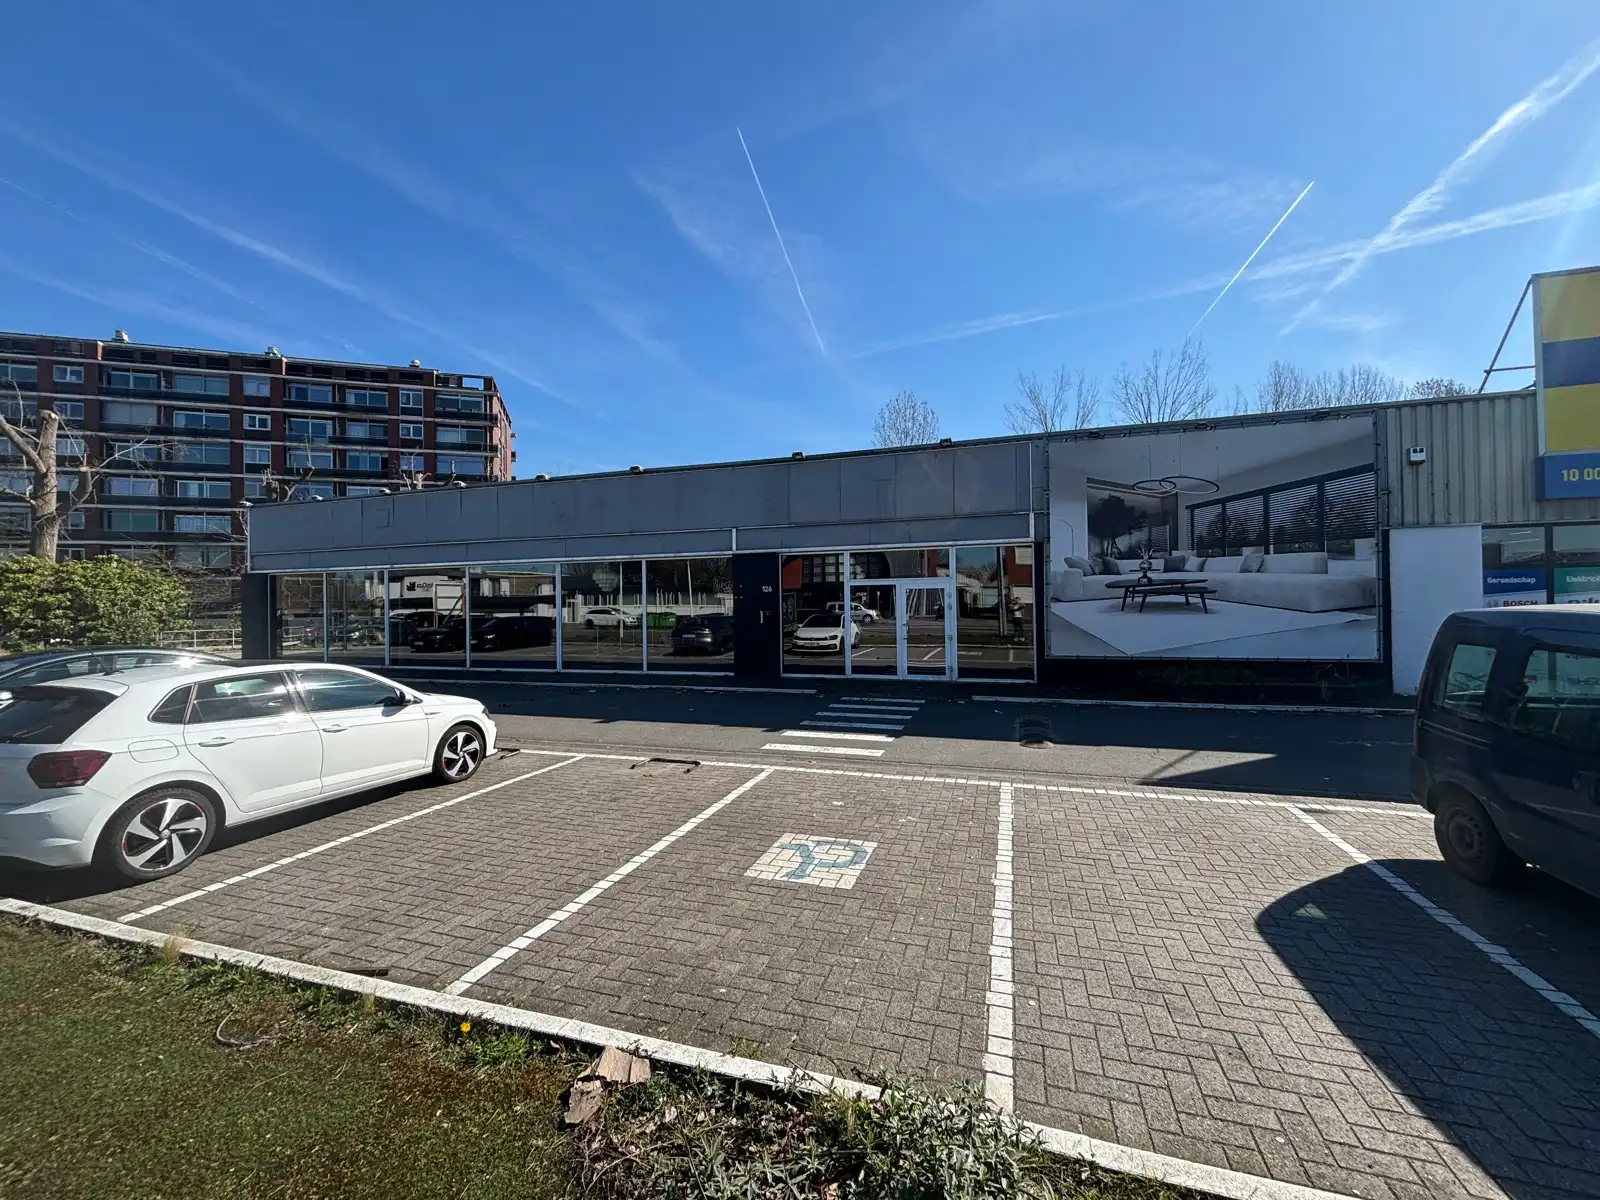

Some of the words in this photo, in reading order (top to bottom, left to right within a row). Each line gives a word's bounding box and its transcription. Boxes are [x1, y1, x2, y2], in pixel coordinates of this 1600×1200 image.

[1561, 469, 1579, 481] 10
[762, 585, 773, 593] 126
[1503, 599, 1538, 607] BOSCH
